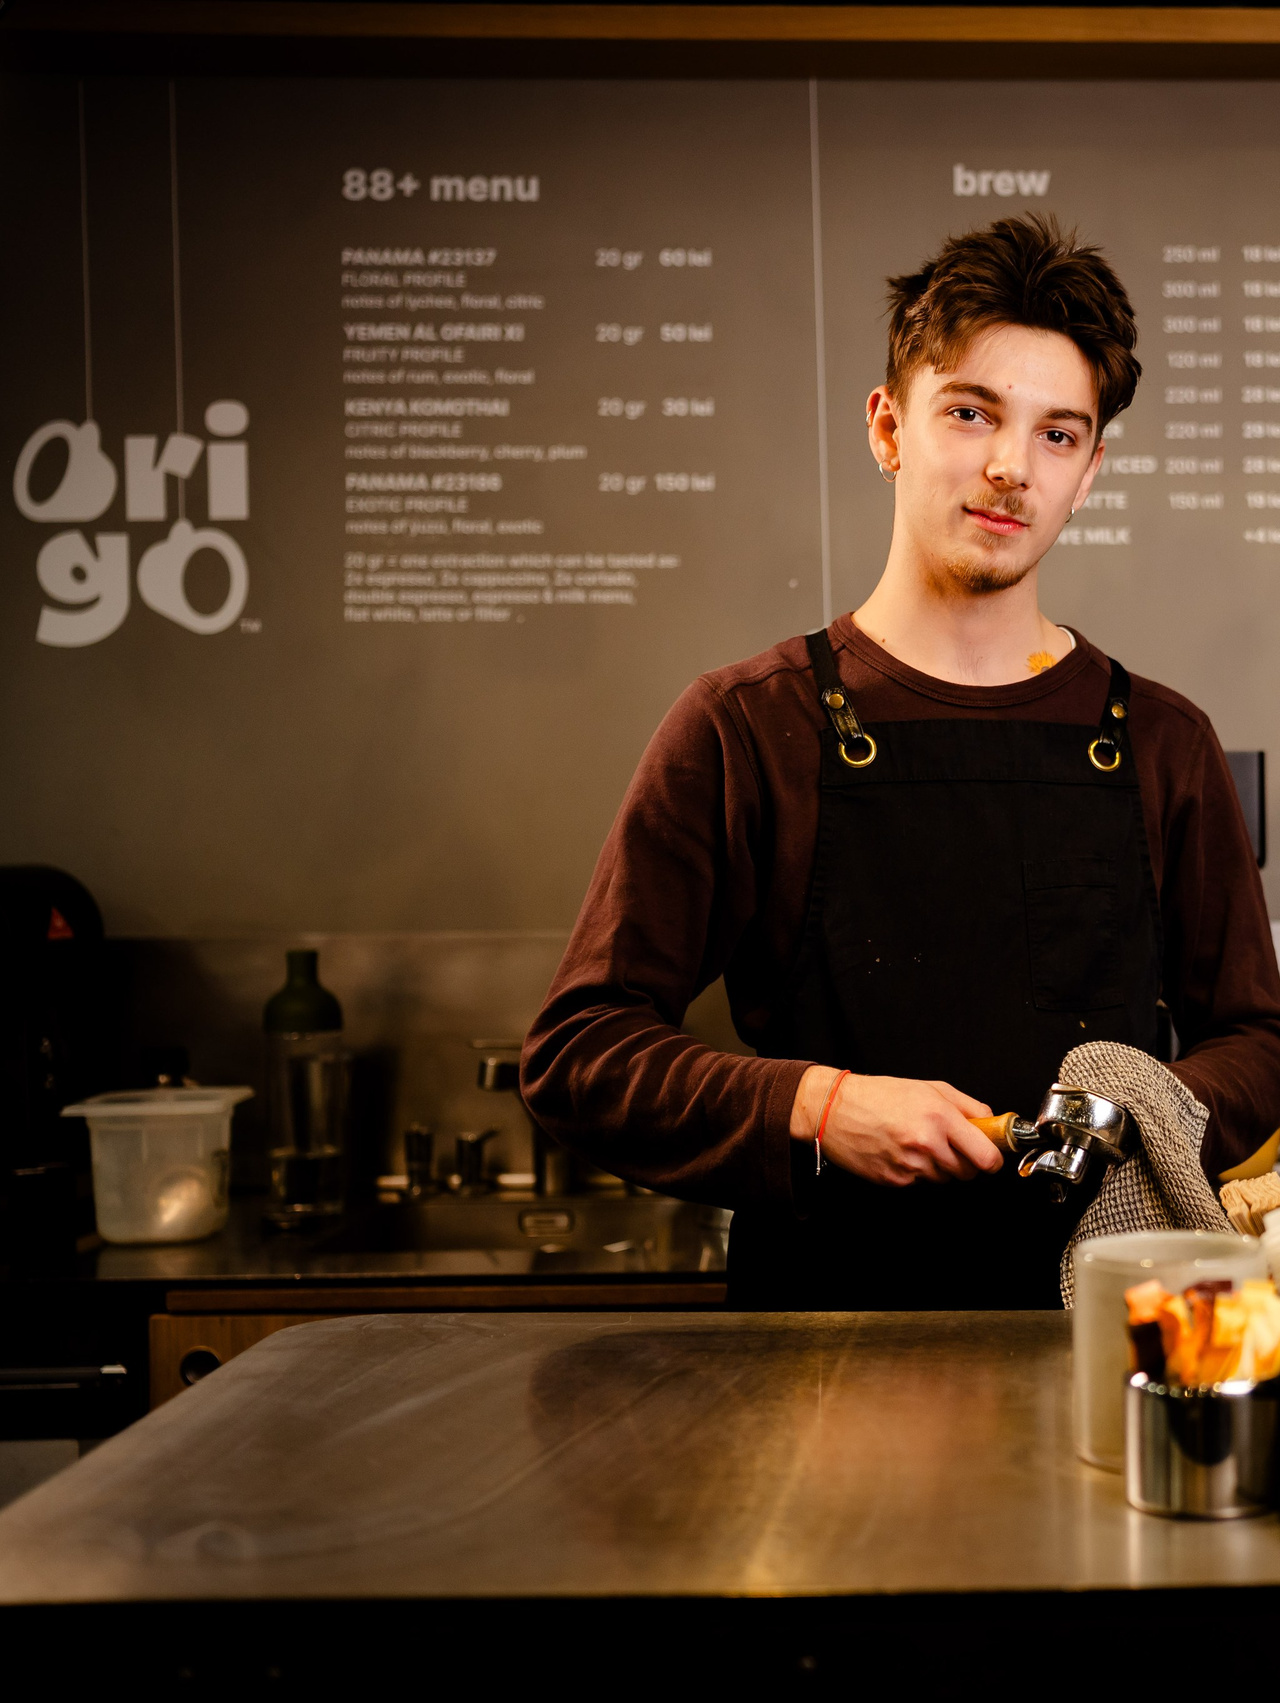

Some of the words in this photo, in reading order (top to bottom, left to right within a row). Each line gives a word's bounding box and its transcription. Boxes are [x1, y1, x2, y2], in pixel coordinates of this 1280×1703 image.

[342, 168, 420, 201] 88+
[430, 175, 540, 202] menu
[953, 164, 1051, 197] brew
[341, 248, 425, 266] PANAMA
[595, 248, 621, 268] 20
[623, 251, 644, 270] gr
[341, 270, 400, 288] FLORAL
[402, 271, 467, 288] PROFILE
[341, 294, 386, 308] notes
[386, 293, 404, 308] of
[343, 323, 411, 341] YEMEN
[412, 323, 438, 341] AL
[596, 323, 621, 343] 20
[623, 326, 644, 345] gr
[342, 346, 399, 363] FRUITY
[400, 346, 465, 363] PROFILE
[343, 369, 387, 383] notes
[388, 368, 405, 383] of
[344, 398, 408, 416] KENYA
[598, 398, 623, 417] 20
[625, 401, 647, 420] gr
[344, 421, 397, 439] CITRIC
[398, 421, 463, 438] PROFILE
[345, 445, 389, 458] notes
[389, 443, 407, 458] of
[1111, 454, 1159, 475] ICED
[345, 473, 429, 492] PANAMA
[598, 473, 624, 493] 20
[626, 476, 647, 495] gr
[345, 496, 403, 515] EXOTIC
[404, 496, 469, 513] PROFILE
[345, 519, 390, 534] notes
[390, 518, 408, 534] of
[1083, 526, 1132, 545] MILK
